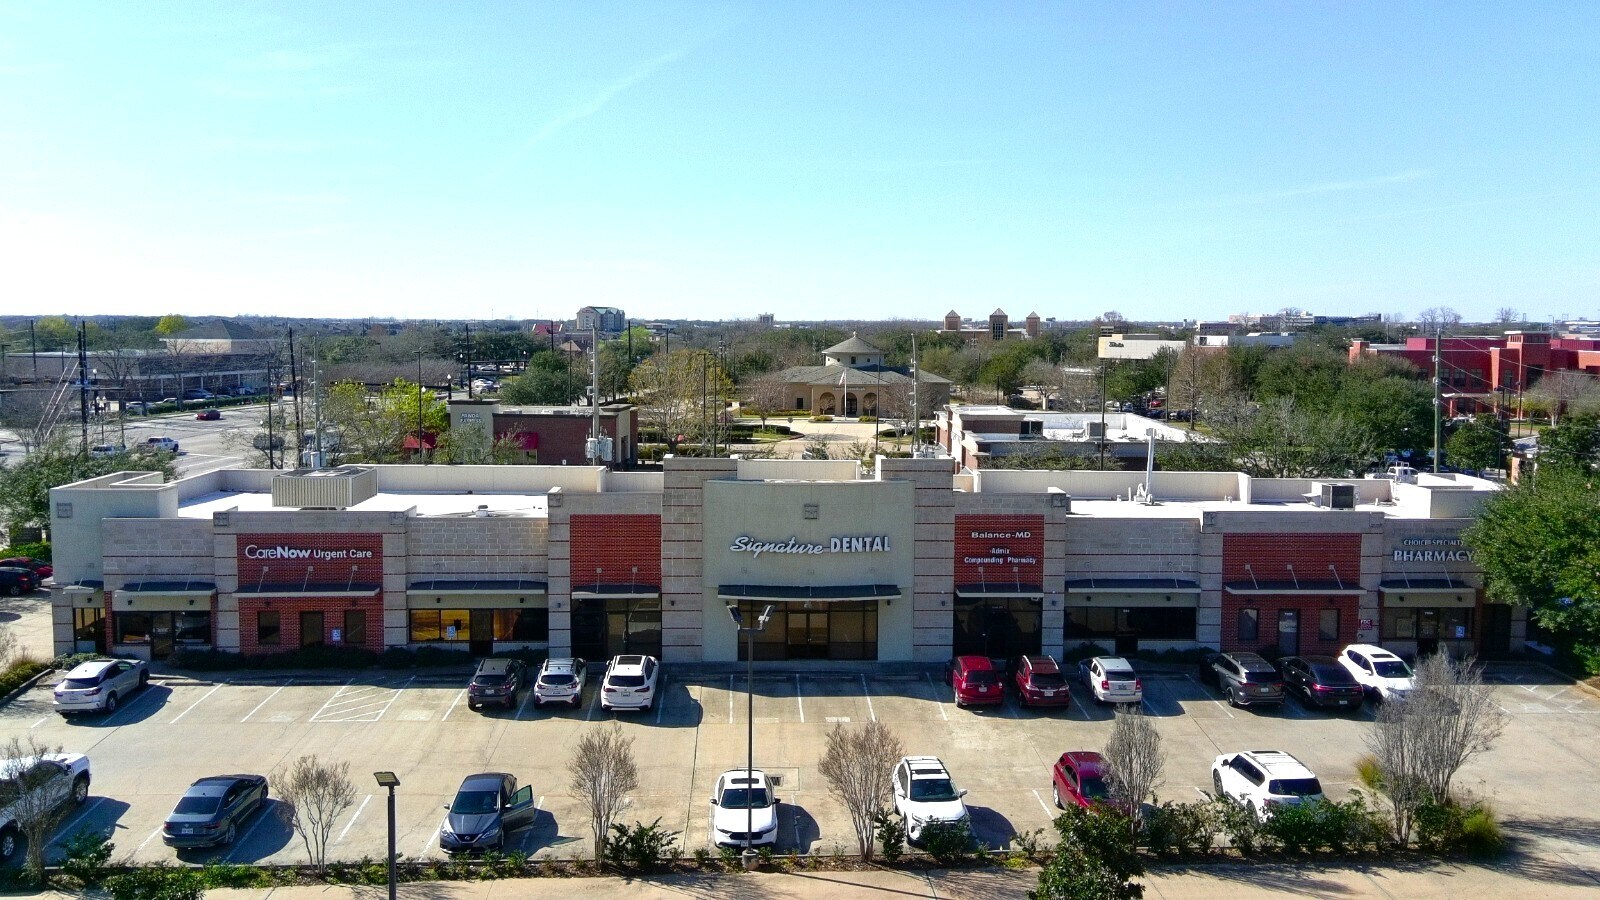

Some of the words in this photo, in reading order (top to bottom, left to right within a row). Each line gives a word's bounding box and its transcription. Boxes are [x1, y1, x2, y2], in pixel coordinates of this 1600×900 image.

[971, 531, 1031, 539] Balance-MD
[730, 536, 824, 558] Signature
[830, 536, 891, 553] DENTAL
[1432, 539, 1464, 547] SPECIALTY
[245, 544, 311, 559] CareNow
[313, 549, 347, 560] Urgent
[349, 549, 373, 558] Care
[1394, 550, 1475, 562] PHARMACY
[964, 556, 1004, 565] Compounding
[1007, 556, 1037, 565] Pharmacy
